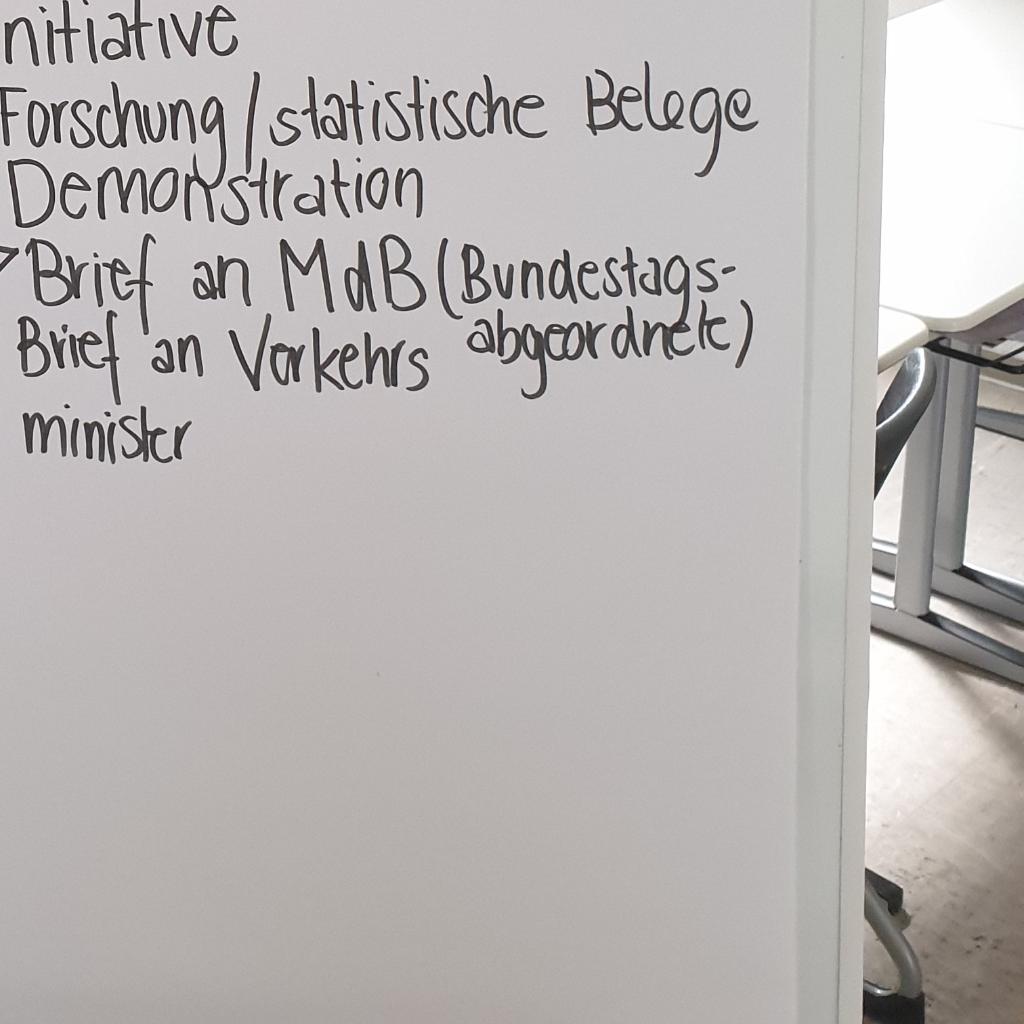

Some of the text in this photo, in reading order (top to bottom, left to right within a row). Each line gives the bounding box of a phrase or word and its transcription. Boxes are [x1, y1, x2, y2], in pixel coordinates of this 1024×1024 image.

[584, 61, 760, 177] Belege
[7, 156, 424, 228] Demonstration
[26, 233, 157, 335] Brief
[191, 259, 251, 310] an
[279, 234, 427, 314] MdB
[18, 311, 121, 405] Brief
[152, 330, 204, 378] an
[466, 299, 755, 399] abgeordnete)
[22, 404, 192, 465] minister
